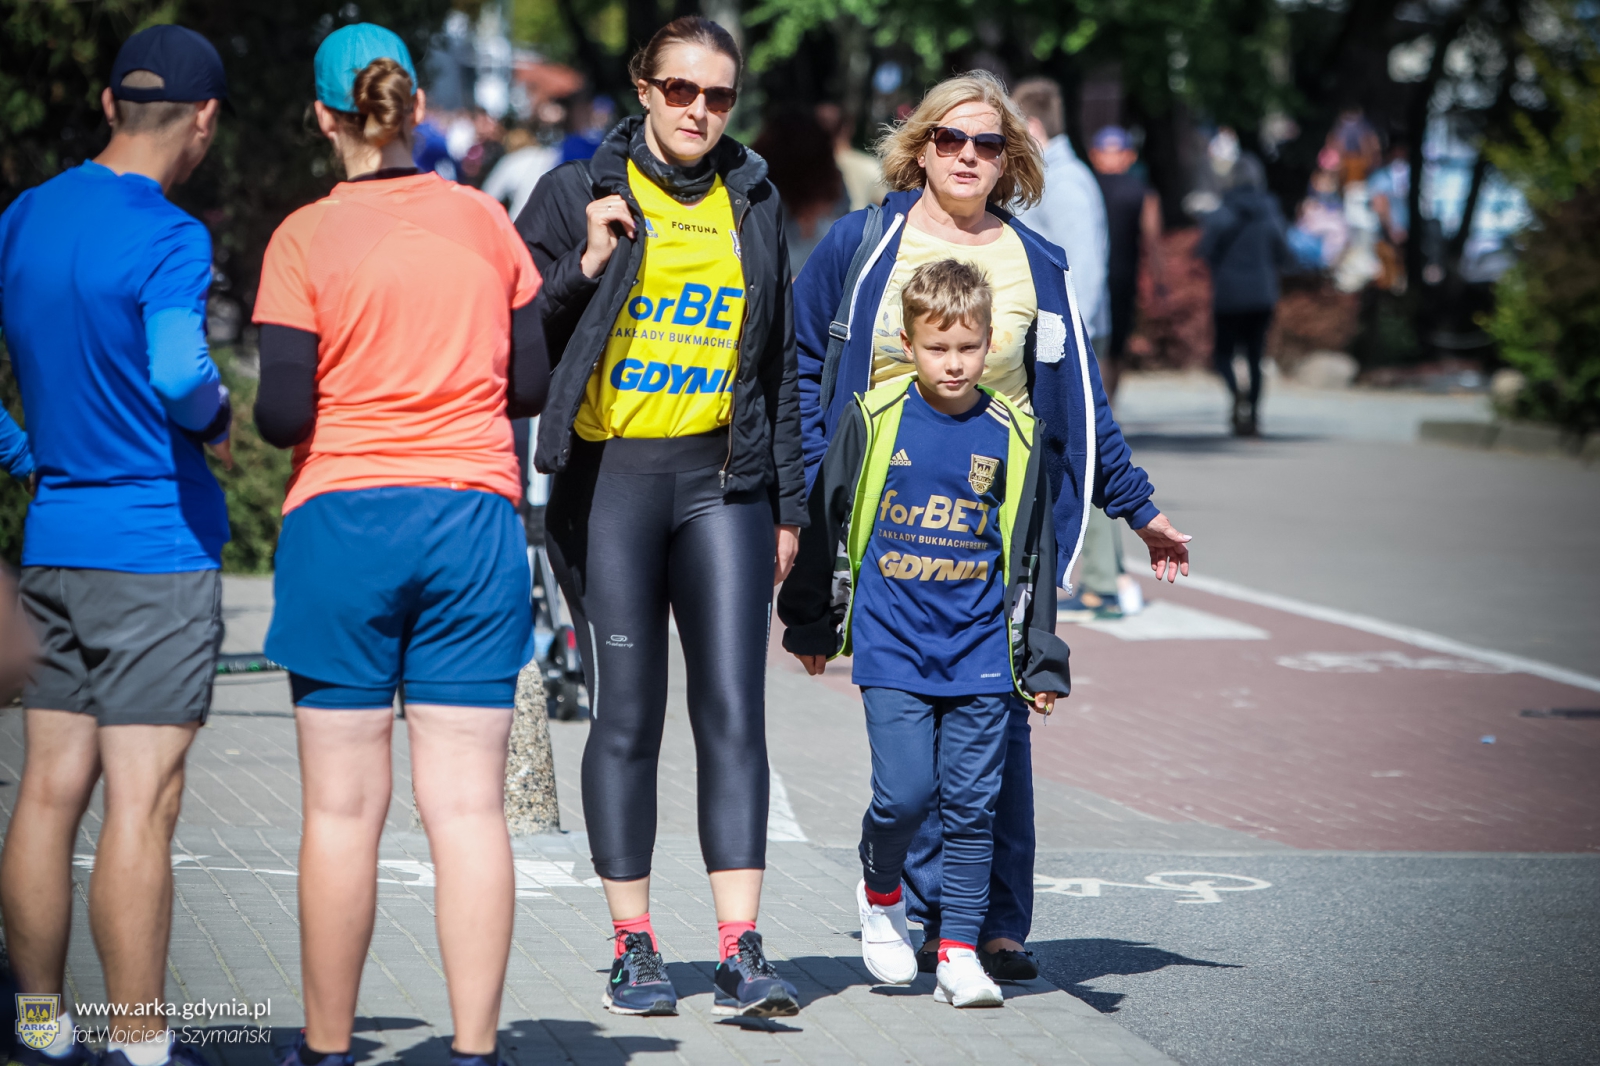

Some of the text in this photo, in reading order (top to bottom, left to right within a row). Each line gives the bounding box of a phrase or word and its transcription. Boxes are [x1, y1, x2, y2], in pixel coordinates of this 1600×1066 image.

[671, 221, 718, 234] FORTUNA
[628, 281, 746, 330] orBE
[610, 327, 665, 341] AKŁADY
[879, 489, 989, 536] forBET
[878, 528, 988, 550] ZAKŁADY BUKMACHERSKIE
[878, 551, 988, 581] GDYNIA
